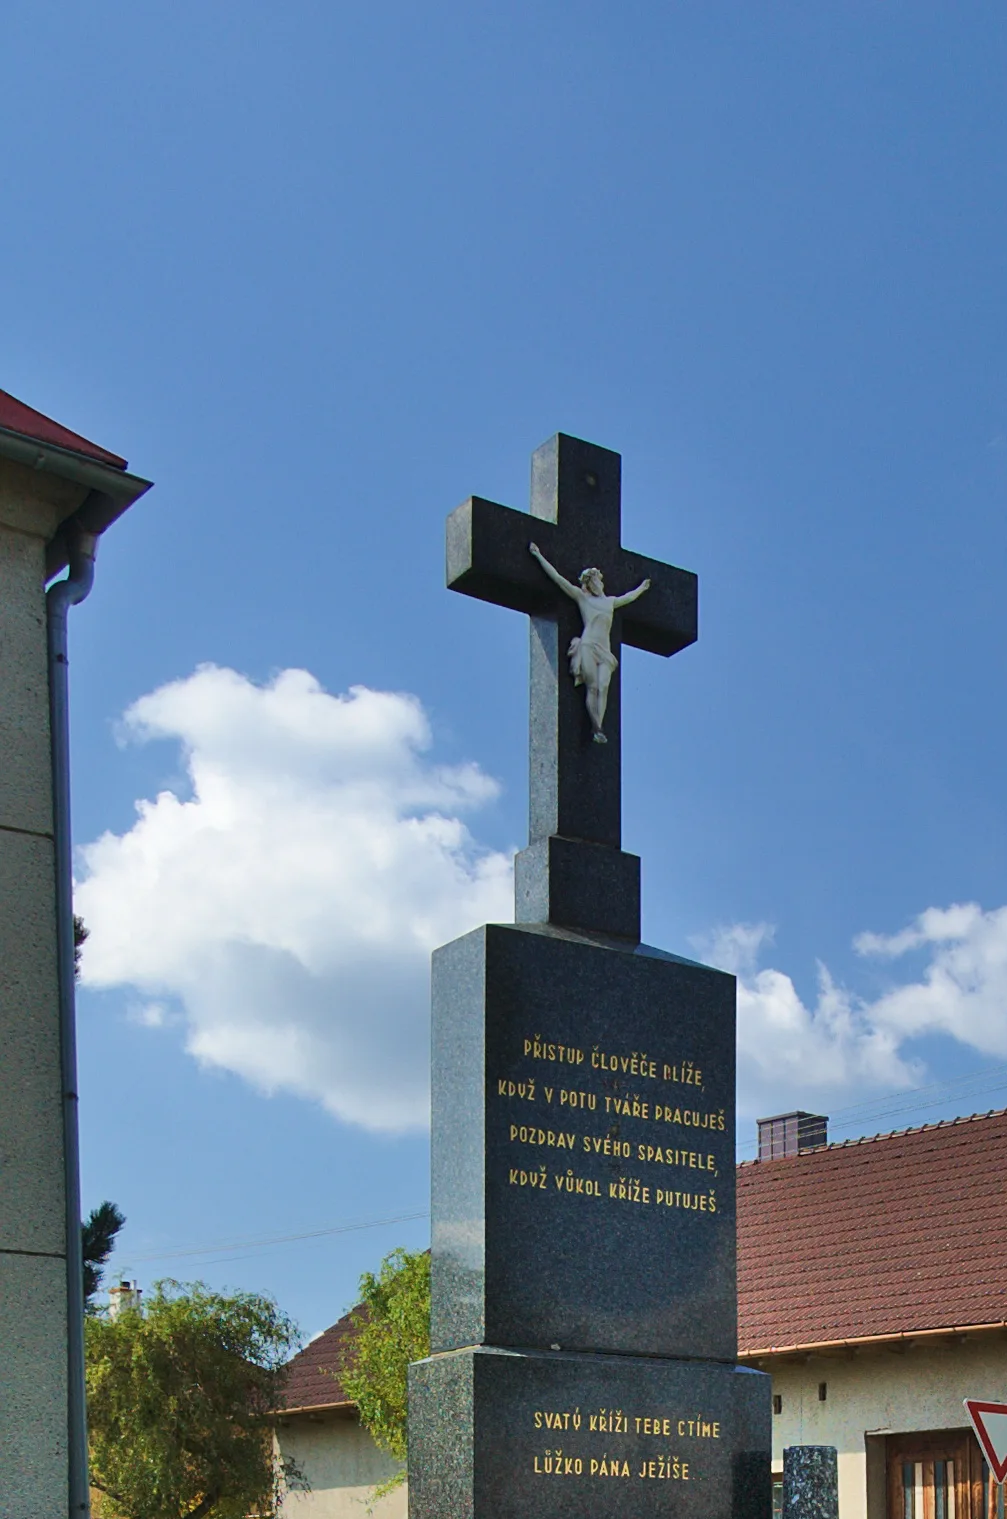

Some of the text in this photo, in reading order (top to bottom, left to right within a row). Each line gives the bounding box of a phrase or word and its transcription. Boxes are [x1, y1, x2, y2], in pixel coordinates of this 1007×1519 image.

[524, 1034, 584, 1064] PŘISTUP
[591, 1045, 656, 1077] ČLOVĚČE
[498, 1078, 535, 1100] KDYŽ
[545, 1087, 553, 1103] V
[561, 1092, 596, 1110] POTU
[605, 1093, 649, 1119] TVÁŘE
[510, 1125, 719, 1177] POZDRAV SVÉHO SPASITELE,
[509, 1165, 547, 1189] KDYŽ
[555, 1170, 601, 1197] VŮKOL
[610, 1177, 649, 1203] KŘÍŽE
[534, 1407, 720, 1438] SVATÝ KŘÍŽI TEBE CTÍME
[534, 1450, 582, 1474] LŮŽKO
[591, 1453, 630, 1477] PÁNA
